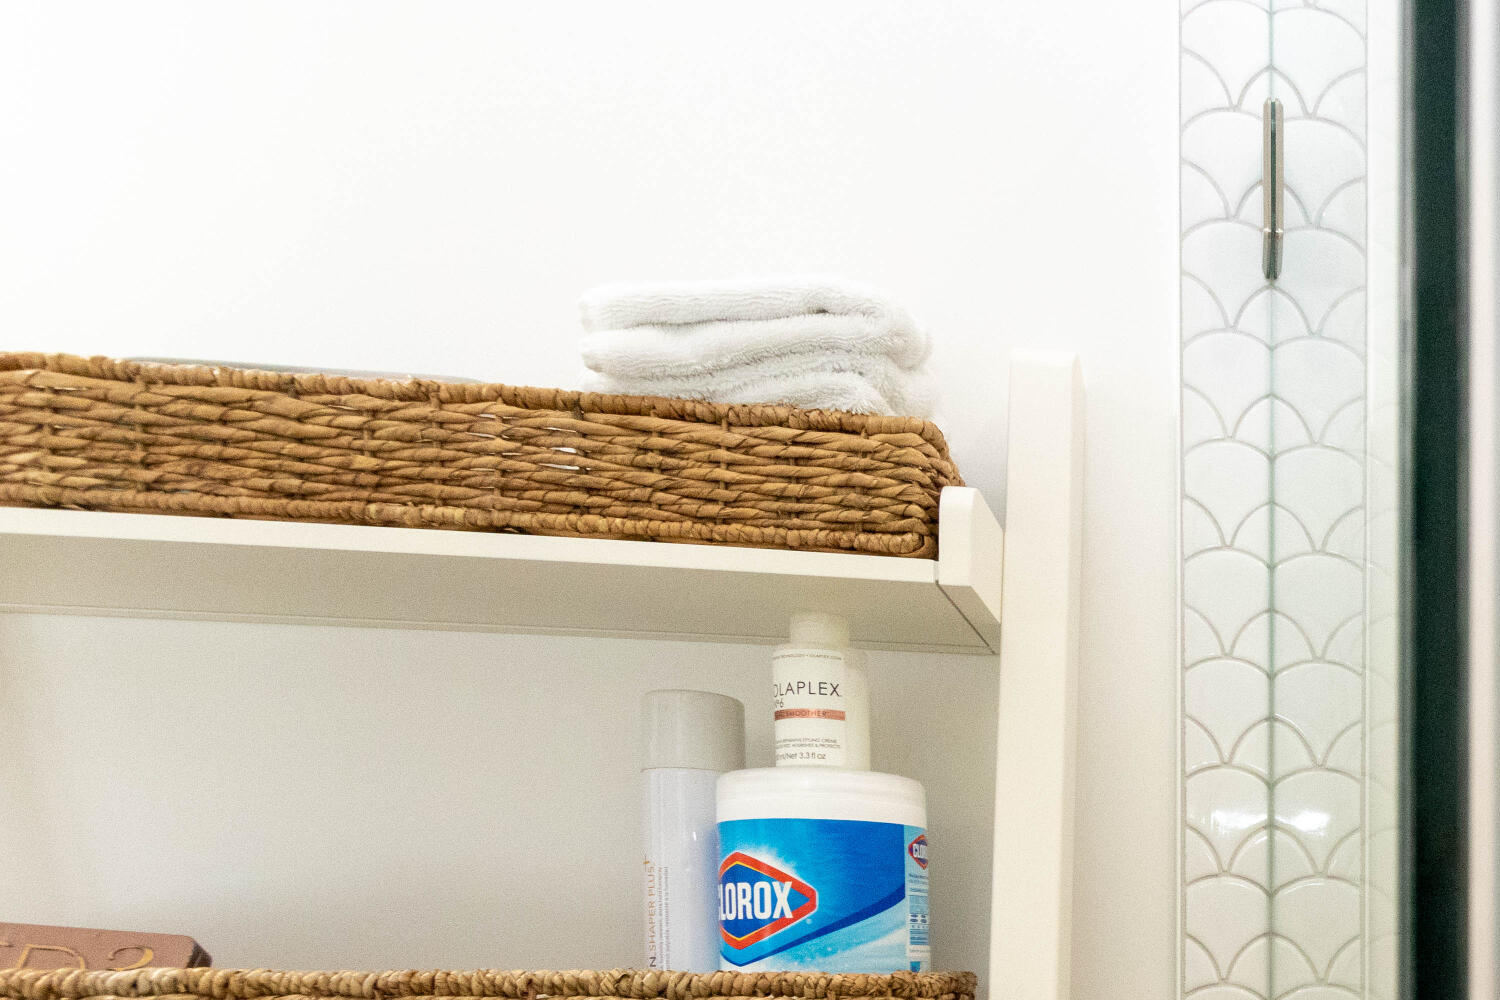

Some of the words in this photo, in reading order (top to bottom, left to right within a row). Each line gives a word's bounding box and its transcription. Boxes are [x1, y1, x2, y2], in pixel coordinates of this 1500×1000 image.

[647, 866, 656, 897] PLUS
[718, 881, 794, 921] LOROX
[648, 900, 657, 952] SHAPER
